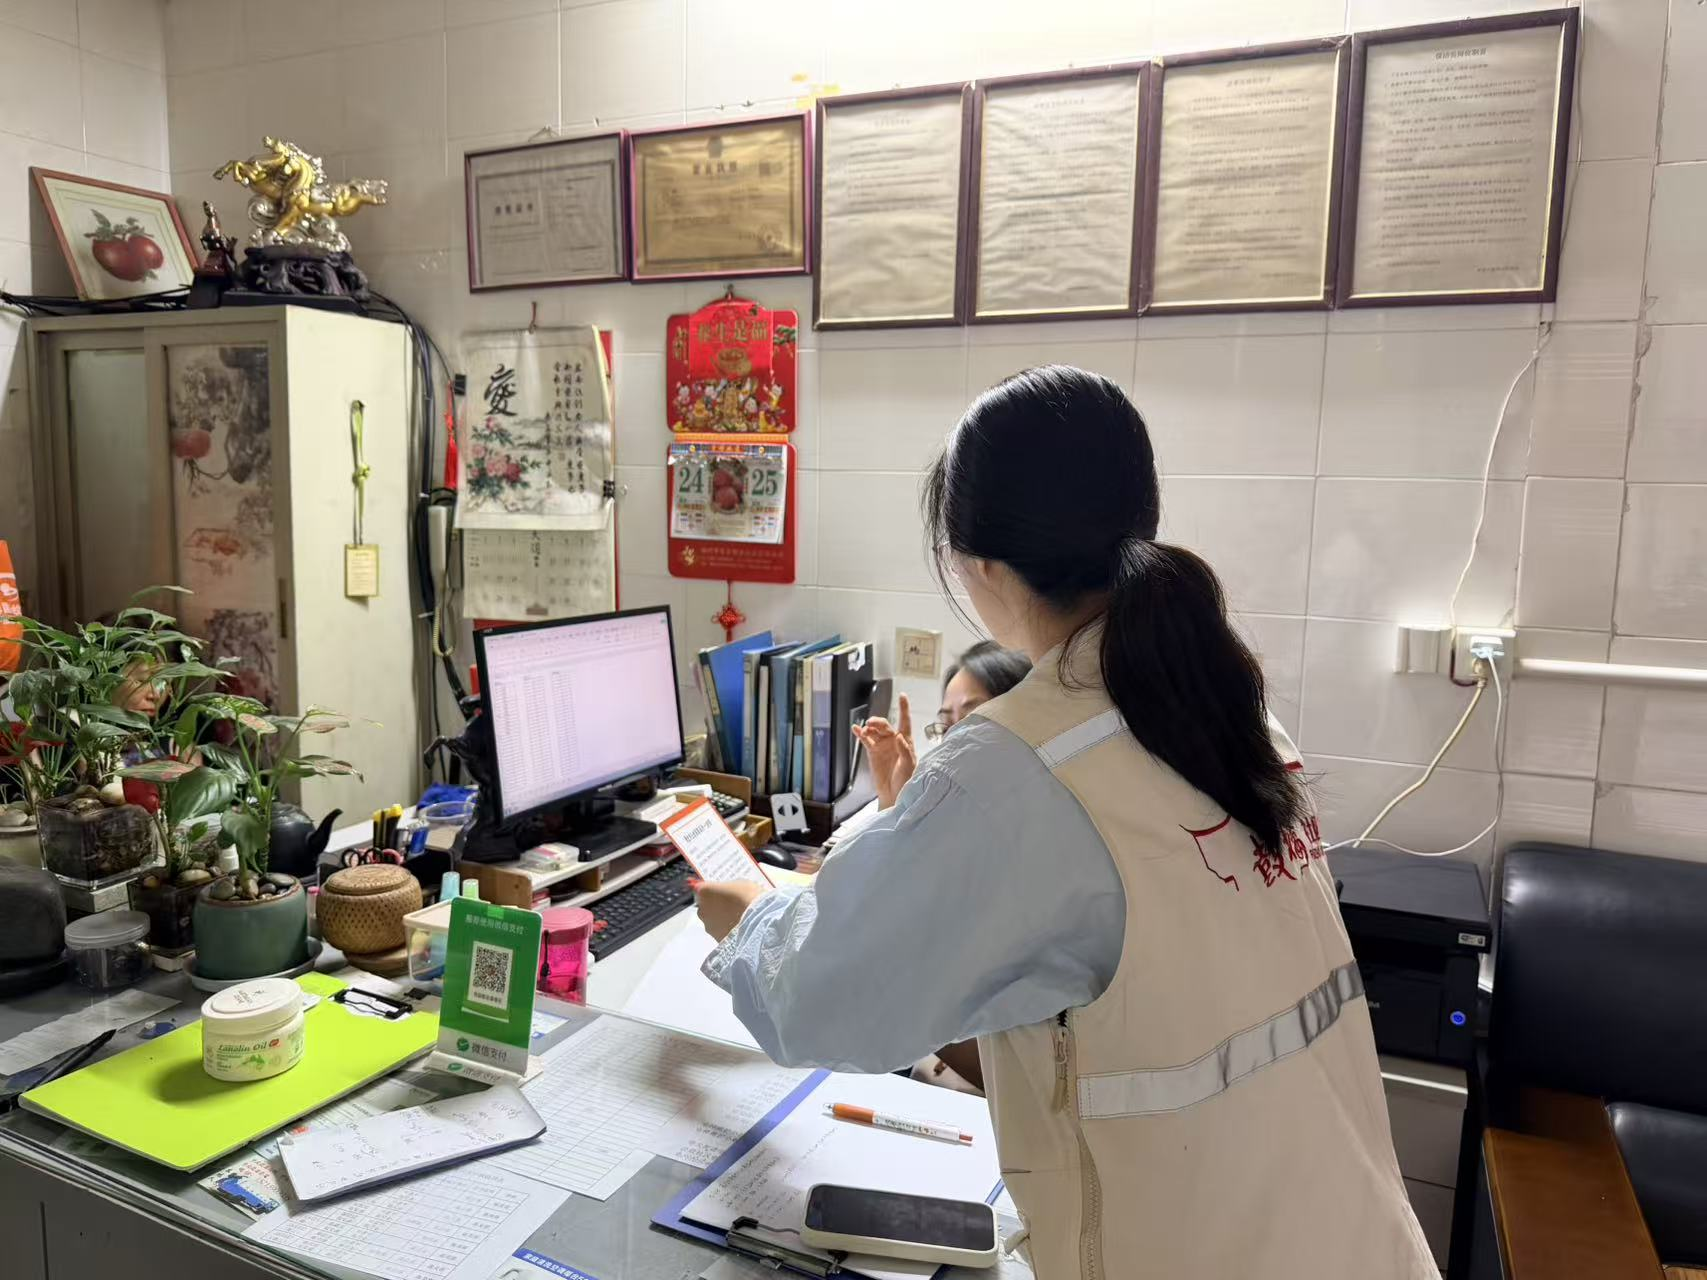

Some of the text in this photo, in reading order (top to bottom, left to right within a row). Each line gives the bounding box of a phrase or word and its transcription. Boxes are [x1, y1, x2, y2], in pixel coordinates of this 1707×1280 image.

[679, 466, 704, 494] 24
[752, 469, 778, 496] 25
[253, 1041, 267, 1051] Oil
[471, 1041, 507, 1062] 微信支付
